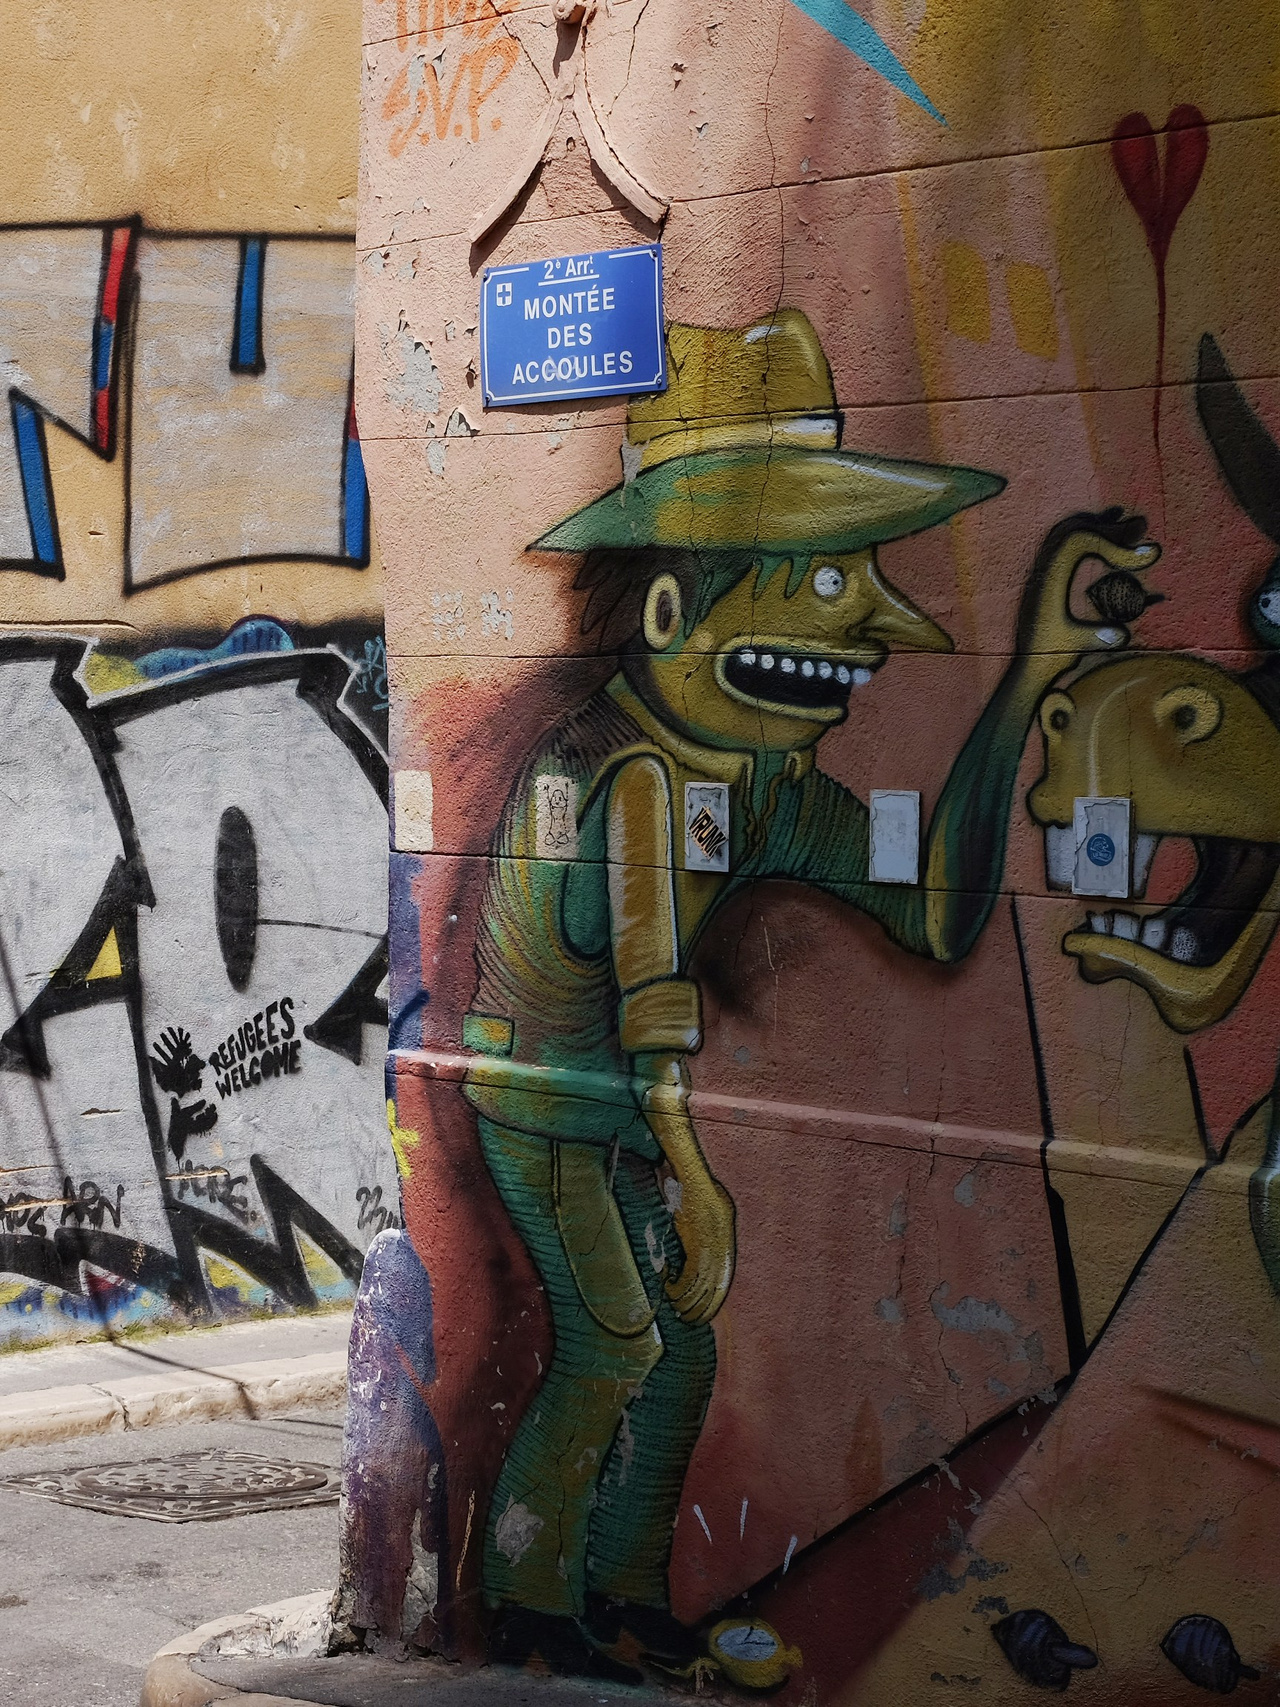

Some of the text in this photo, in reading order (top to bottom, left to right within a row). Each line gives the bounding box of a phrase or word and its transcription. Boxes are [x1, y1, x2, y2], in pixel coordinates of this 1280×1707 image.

[524, 284, 616, 320] MONTÉE
[547, 323, 593, 349] DES
[512, 350, 634, 385] ACCOULES
[209, 996, 296, 1076] REFUGEES
[214, 1038, 301, 1101] WELCOME
